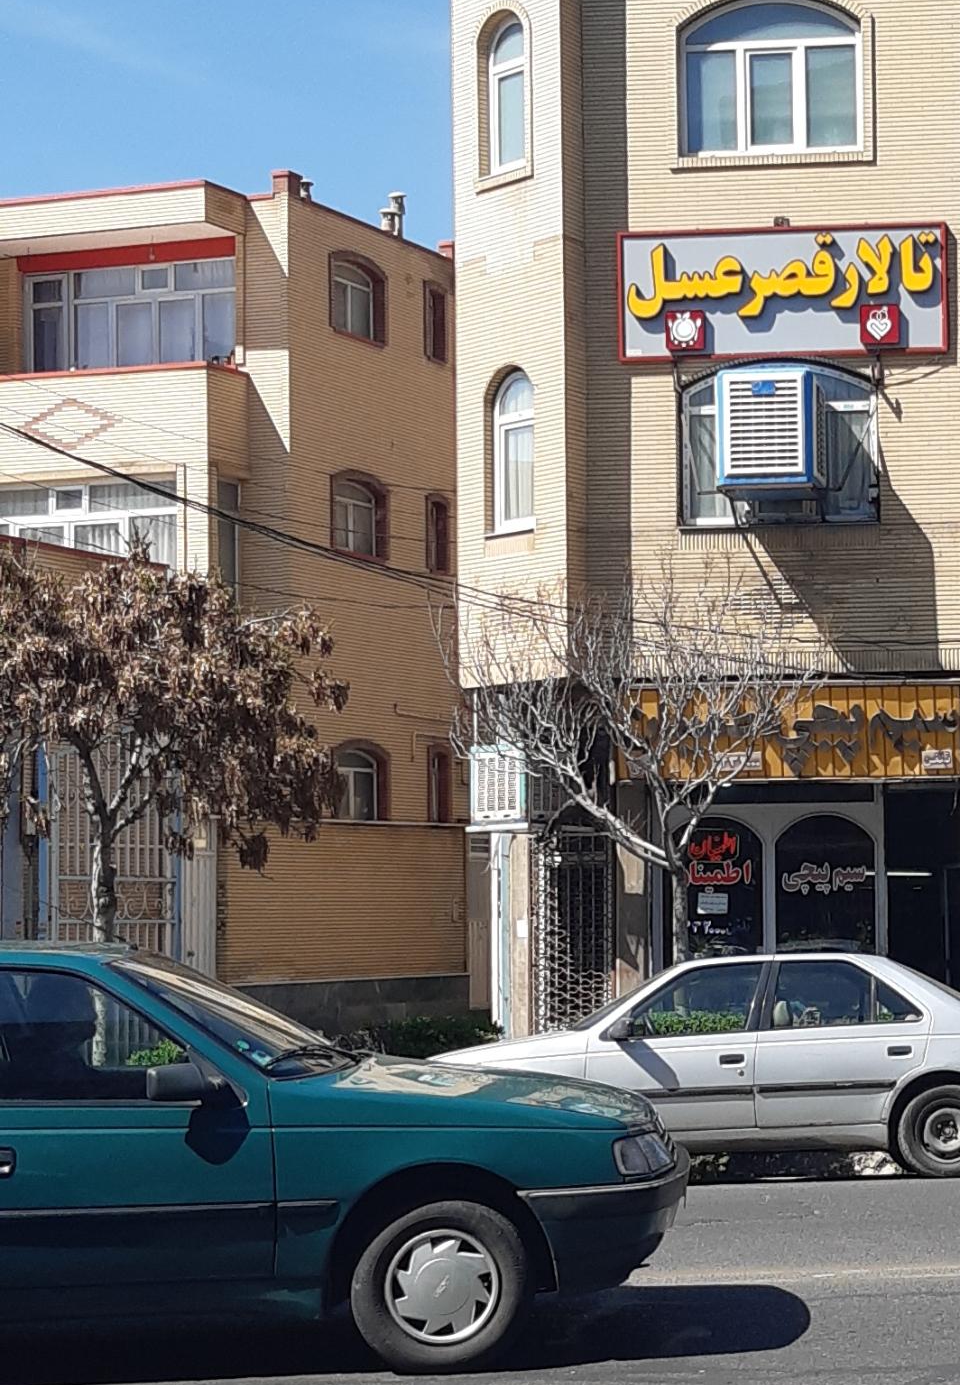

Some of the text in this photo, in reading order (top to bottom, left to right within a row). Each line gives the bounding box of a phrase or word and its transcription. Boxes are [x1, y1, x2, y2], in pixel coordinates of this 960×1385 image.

[627, 231, 936, 319] تالار قصر عسل
[782, 862, 867, 896] سیم پیچی
